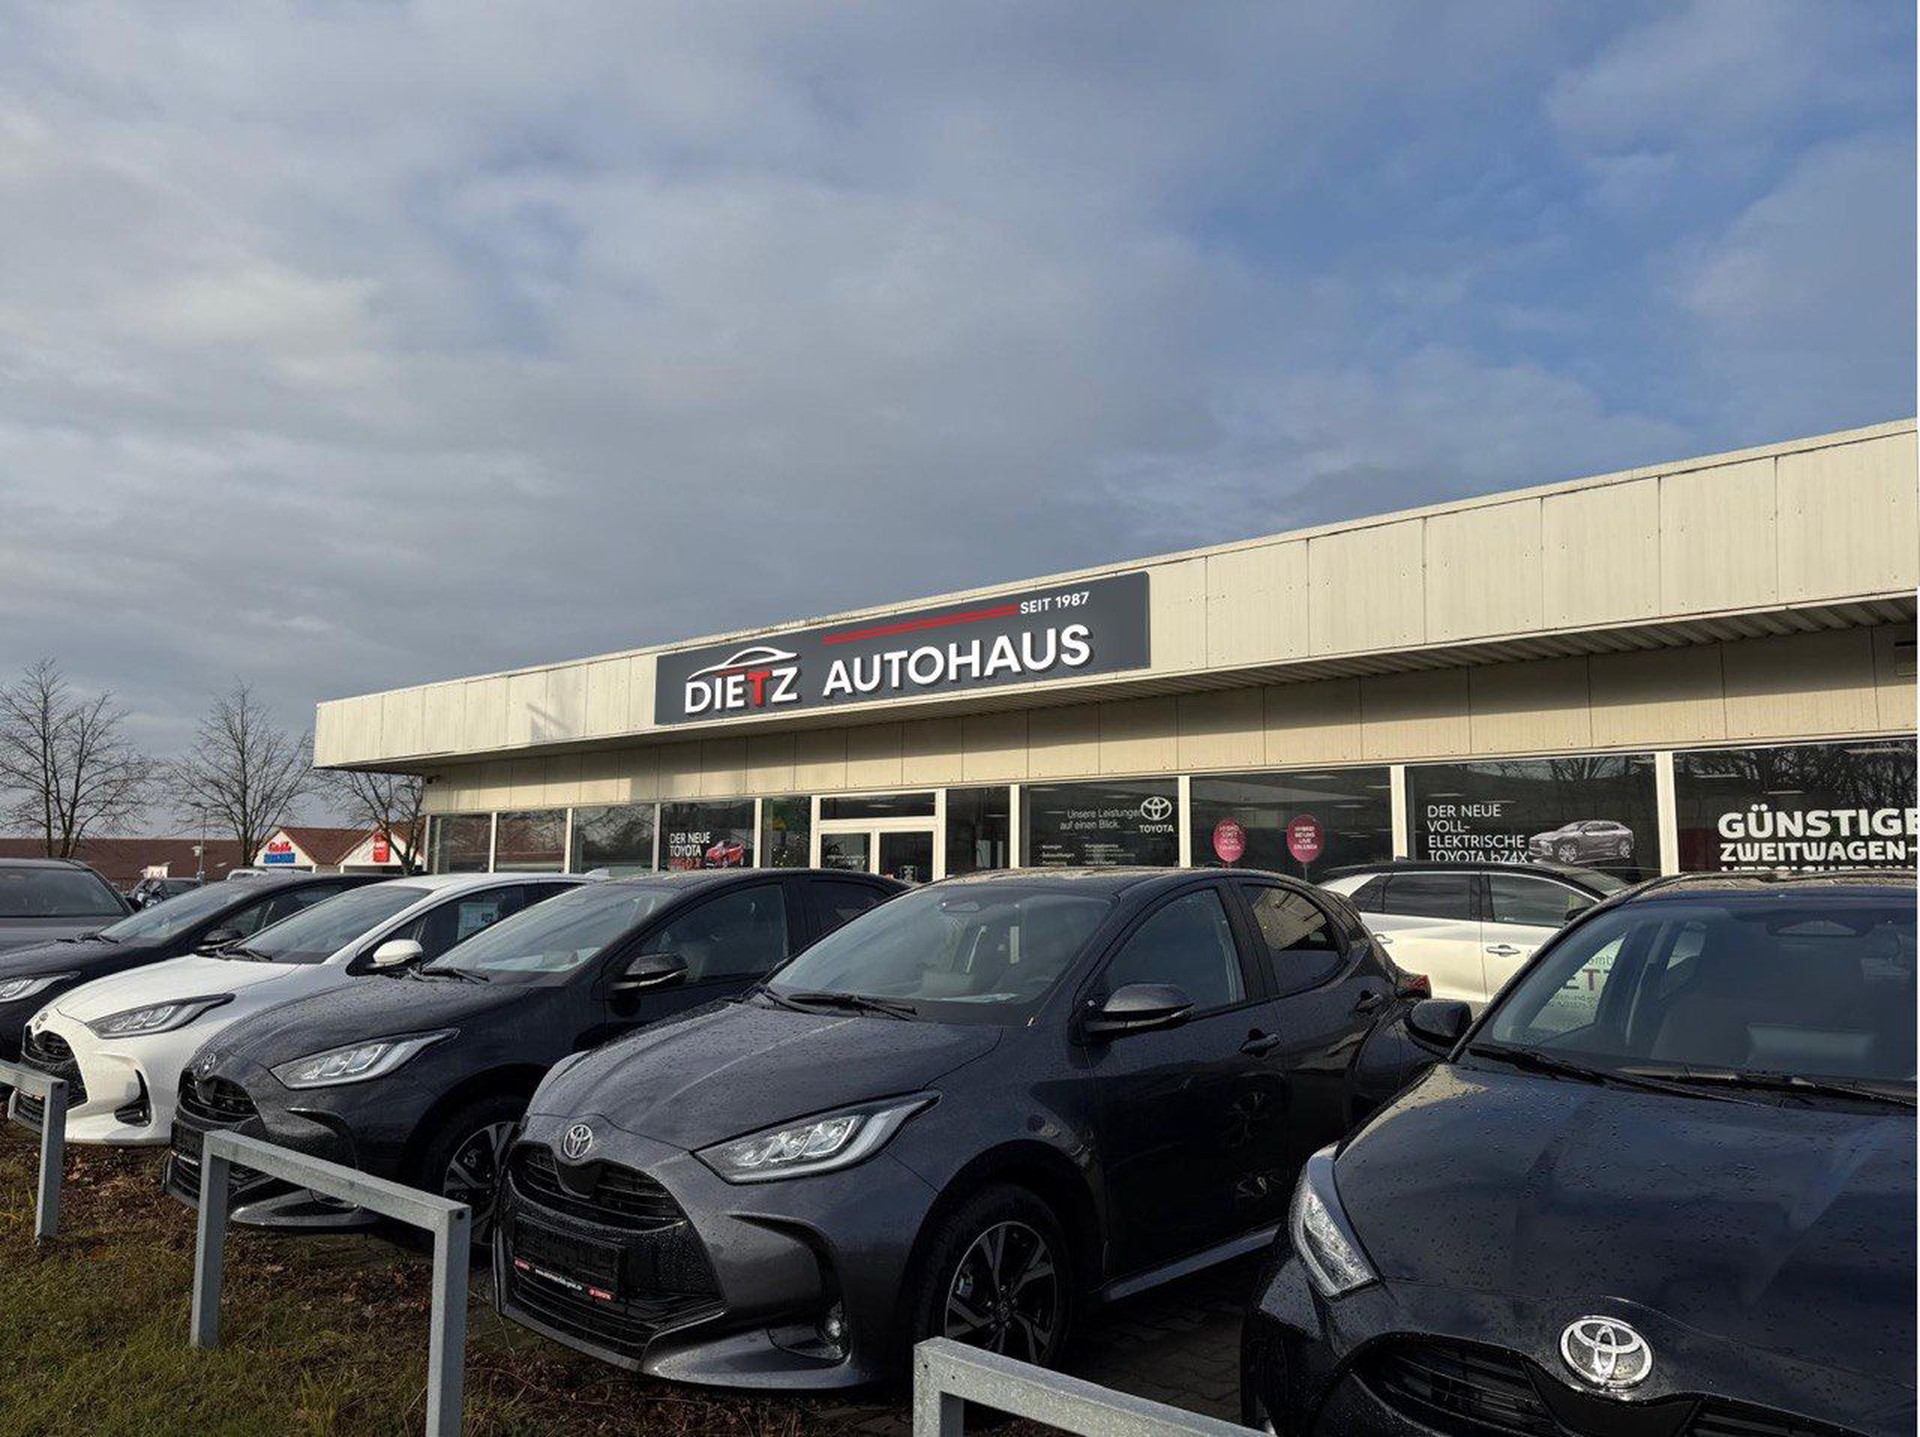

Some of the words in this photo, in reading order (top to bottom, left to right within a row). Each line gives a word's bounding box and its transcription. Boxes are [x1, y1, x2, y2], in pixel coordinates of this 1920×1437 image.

[1020, 598, 1052, 615] SEIT
[1055, 591, 1090, 609] 1987
[684, 665, 799, 715] DIETZ
[822, 623, 1092, 697] AUTOHAUS
[1067, 808, 1097, 819] Unsere
[1427, 804, 1457, 818] DER
[1461, 804, 1502, 818] NEUE
[1060, 820, 1074, 830] auf
[1075, 820, 1097, 830] einen
[1139, 824, 1175, 834] TOYOTA
[1426, 820, 1471, 833] VOLL-
[669, 833, 686, 844] DER
[688, 832, 710, 844] NEUE
[1428, 835, 1526, 848] ELEKTRISCHE
[669, 845, 702, 857] TOYOTA
[1428, 850, 1486, 862] TOYOTA
[1491, 850, 1529, 864] bZ4X
[1719, 841, 1917, 862] ZWEITWAGEN-
